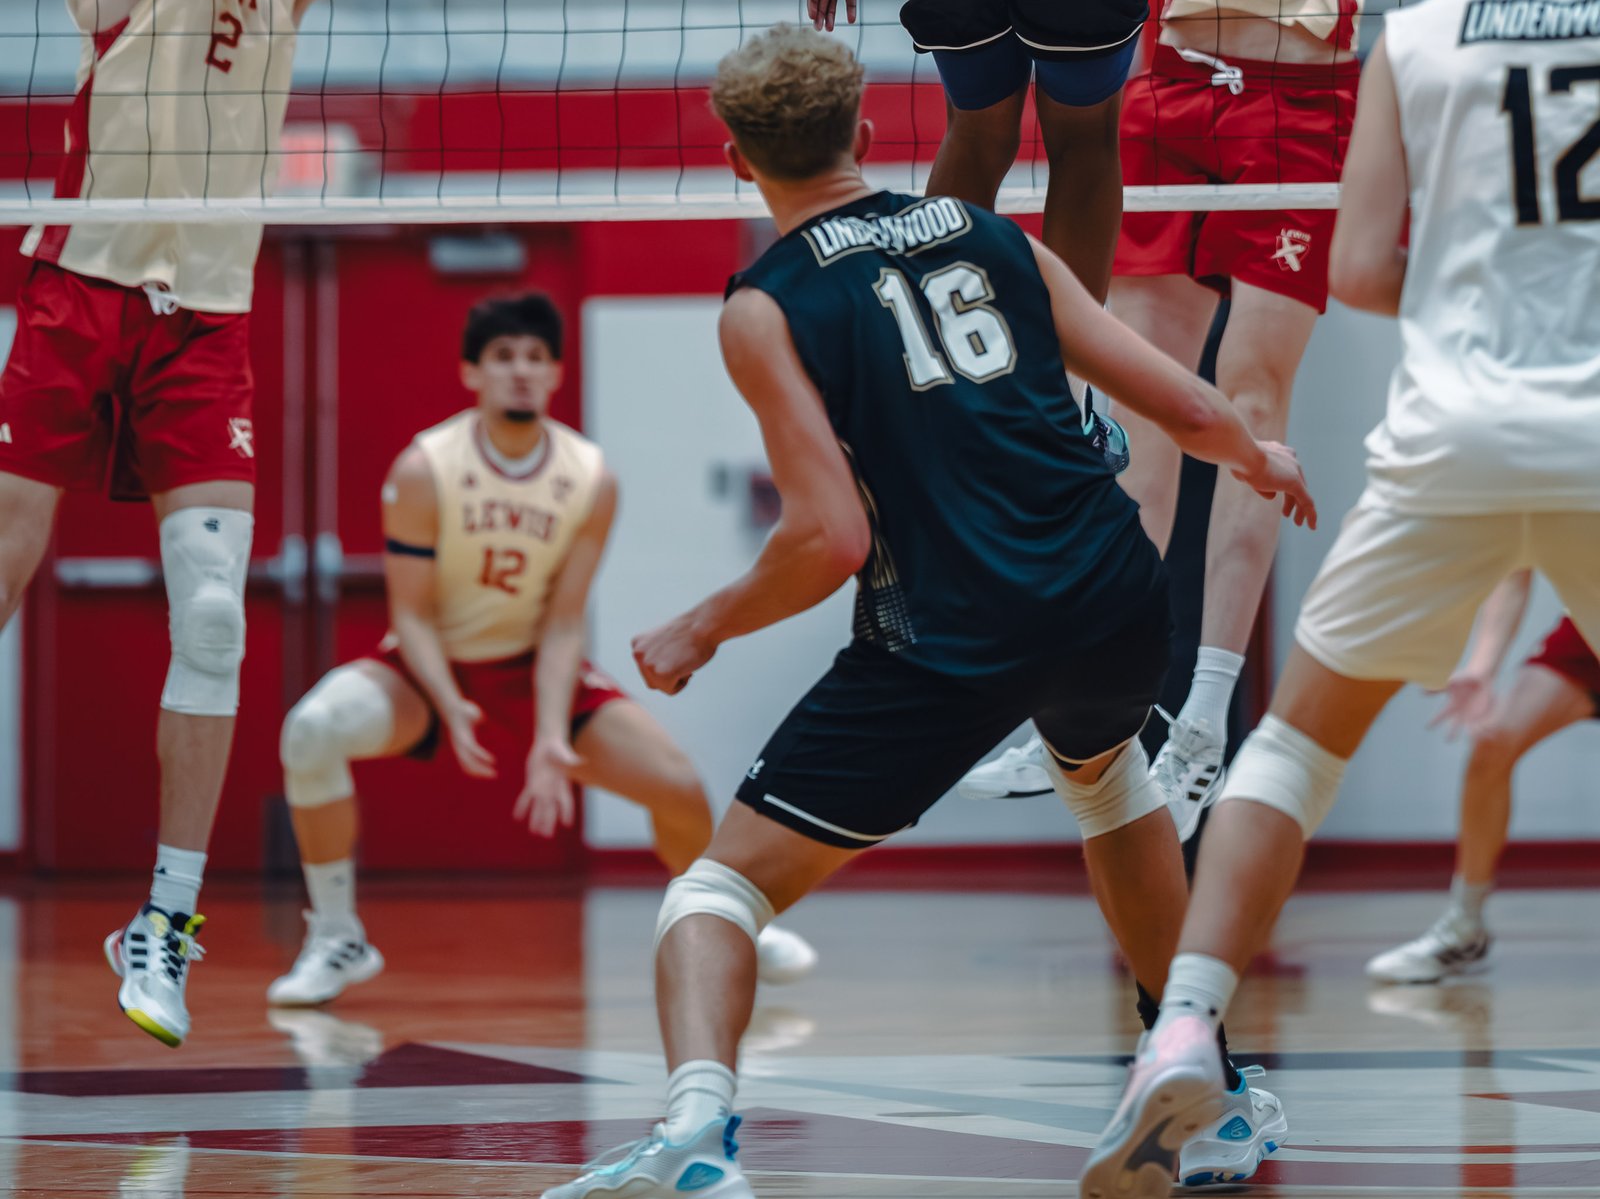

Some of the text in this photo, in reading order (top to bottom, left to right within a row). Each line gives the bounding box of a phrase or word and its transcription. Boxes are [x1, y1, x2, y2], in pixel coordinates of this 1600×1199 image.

[205, 10, 243, 75] 2
[1500, 64, 1600, 226] 12
[872, 261, 1018, 391] 16
[478, 545, 528, 596] 12
